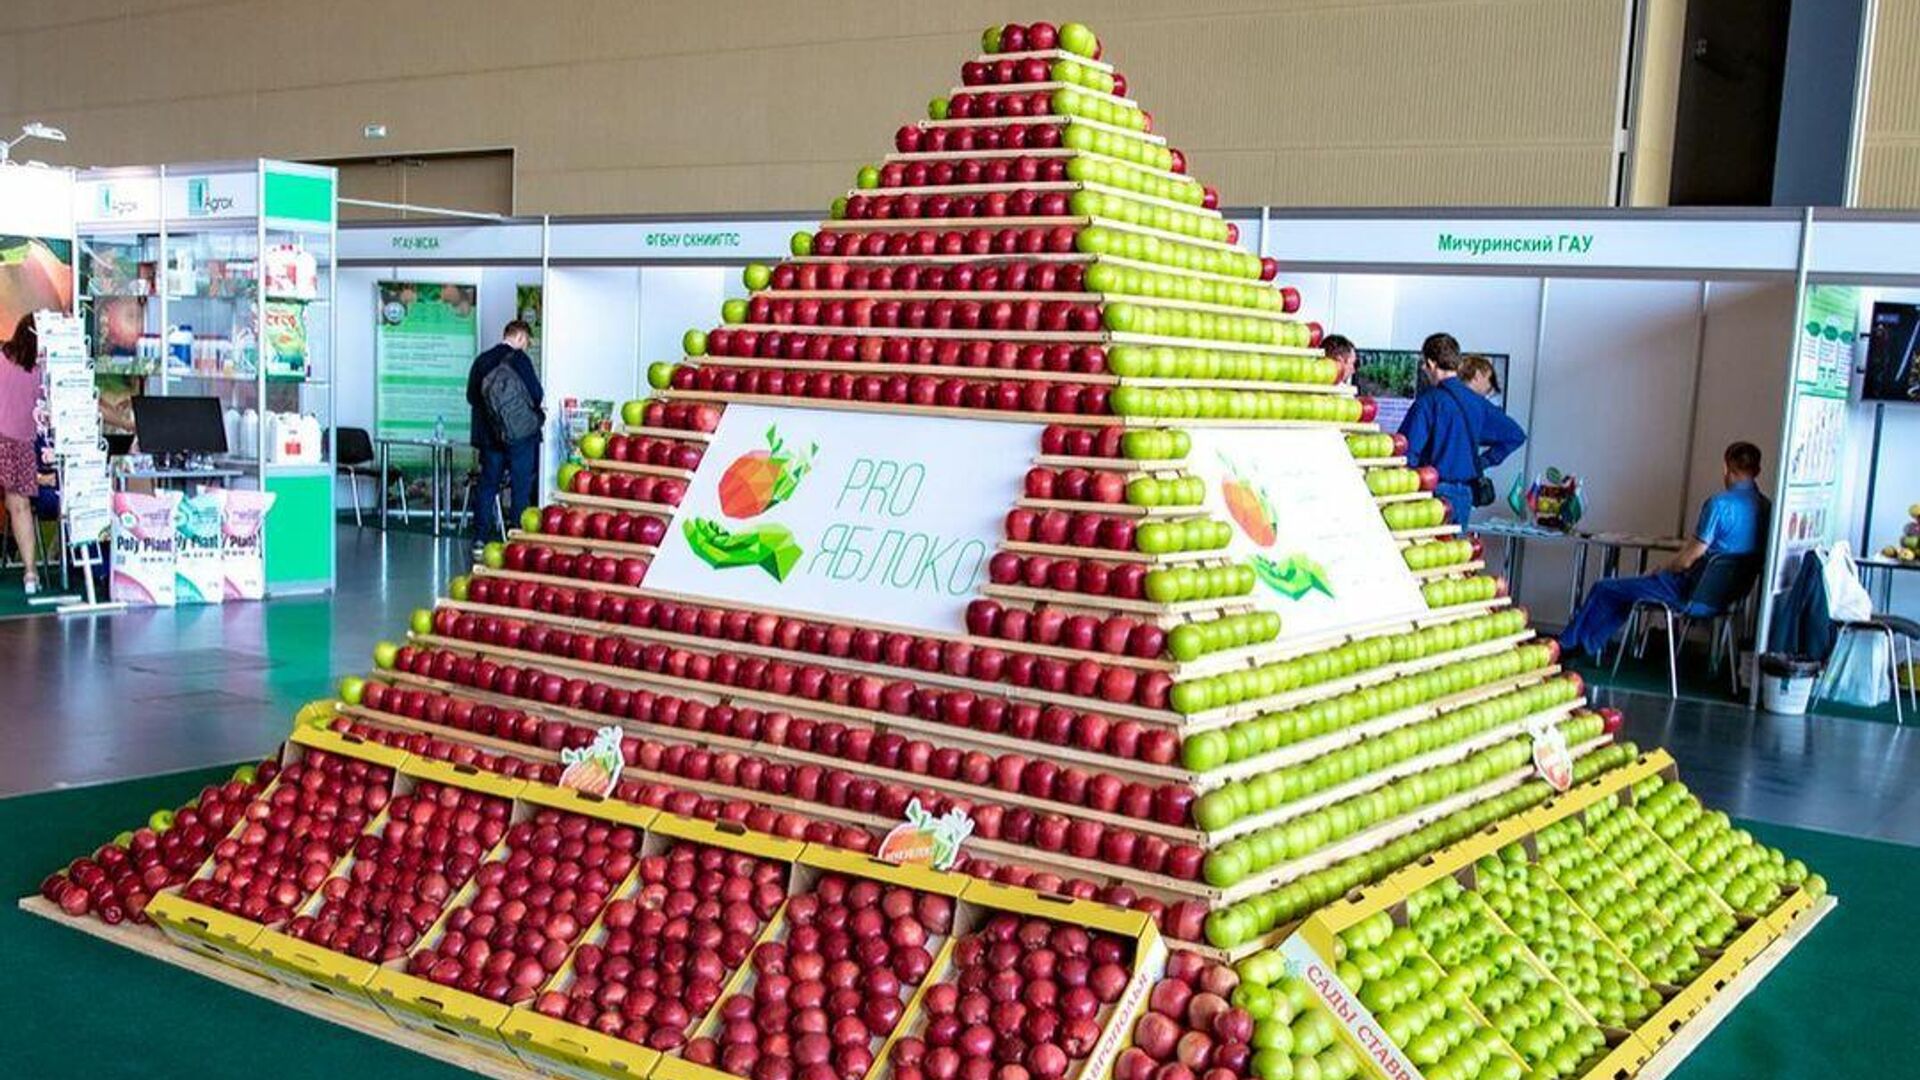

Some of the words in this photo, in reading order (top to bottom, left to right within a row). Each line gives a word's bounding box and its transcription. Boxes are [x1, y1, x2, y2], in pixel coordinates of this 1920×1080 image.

[1438, 234, 1553, 255] Мичуринский
[1558, 235, 1593, 252] ГАУ
[836, 459, 926, 517] PRO
[117, 536, 139, 554] Poly
[143, 537, 172, 551] Plant
[807, 523, 987, 597] ЯБЛОКО
[1307, 965, 1357, 1023] САДЫ
